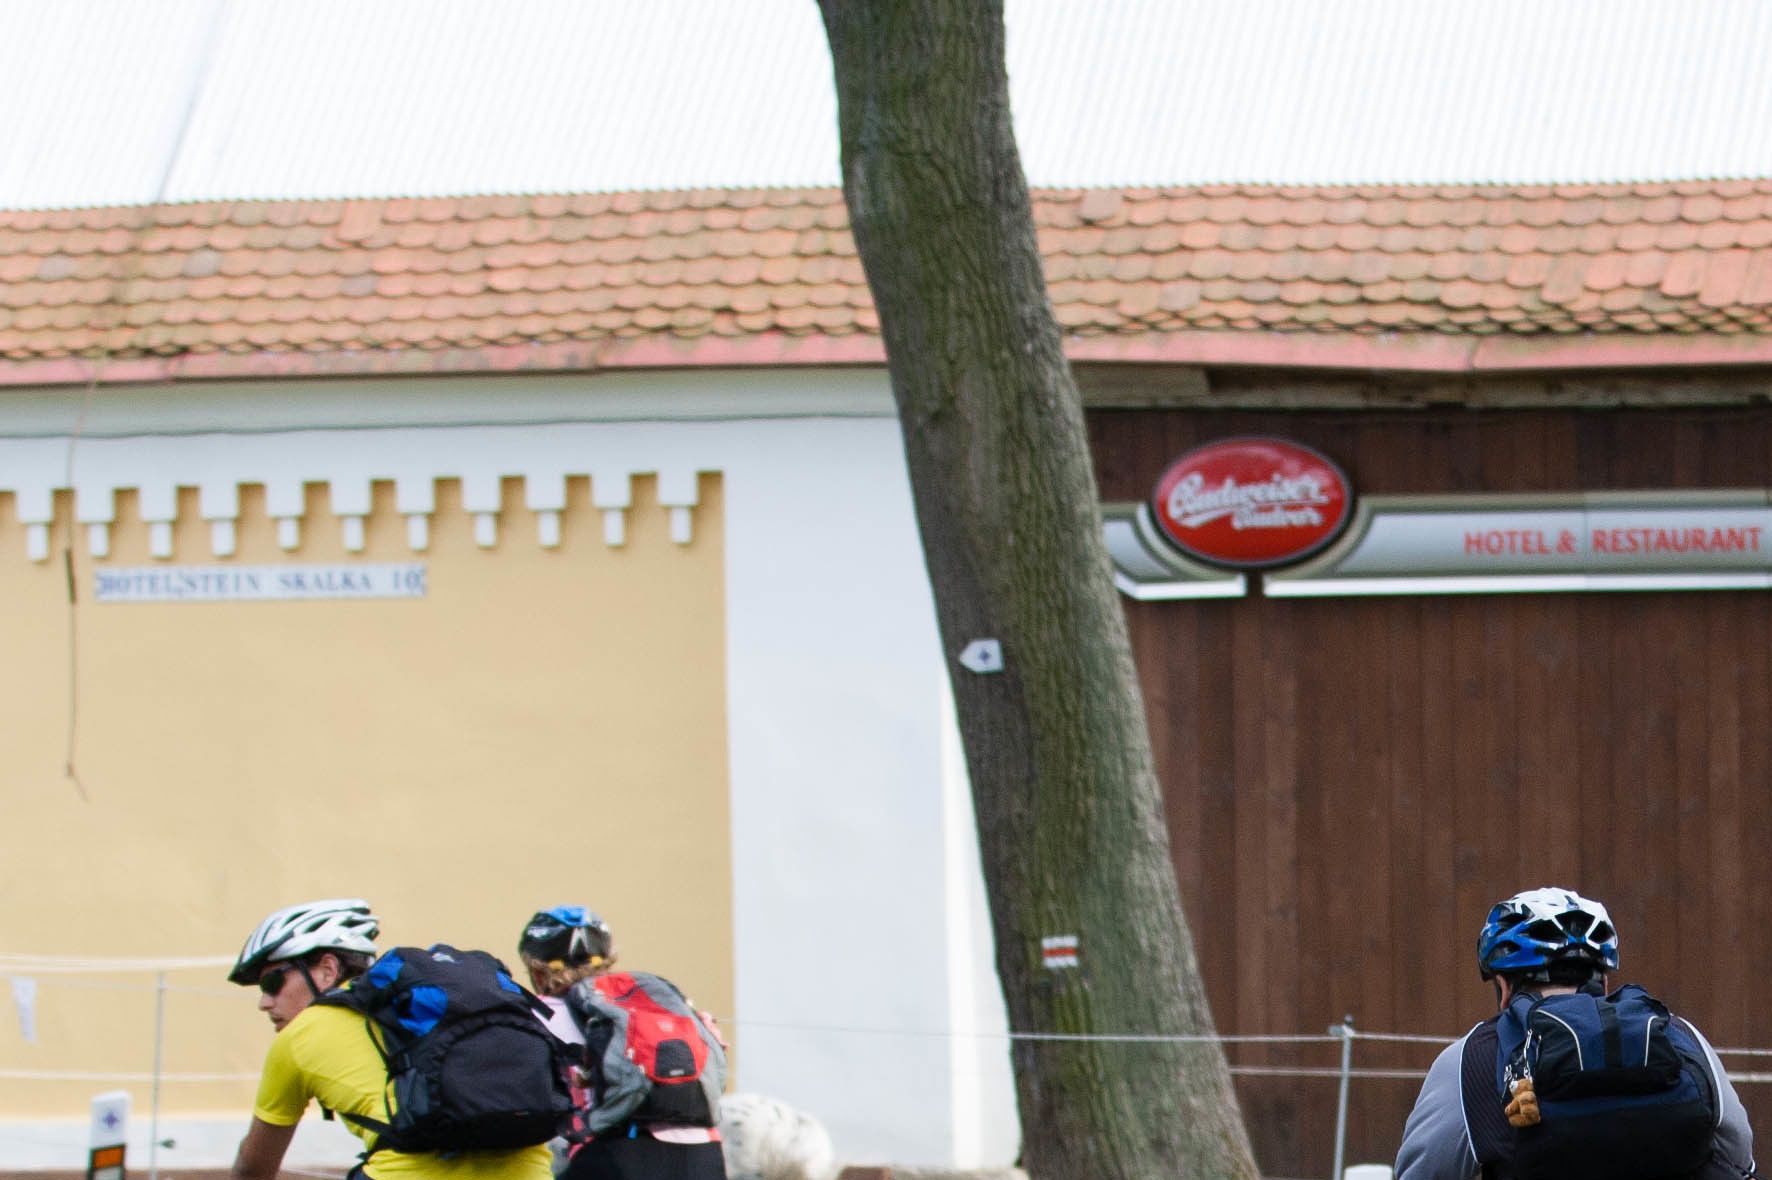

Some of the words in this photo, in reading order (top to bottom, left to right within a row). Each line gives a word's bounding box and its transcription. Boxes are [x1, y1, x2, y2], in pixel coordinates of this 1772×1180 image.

[1168, 472, 1330, 529] Budweiser
[1464, 530, 1550, 555] HOTEL
[1556, 530, 1577, 554] &
[1592, 527, 1762, 553] RESTAURANT
[278, 571, 372, 593] SKALKA
